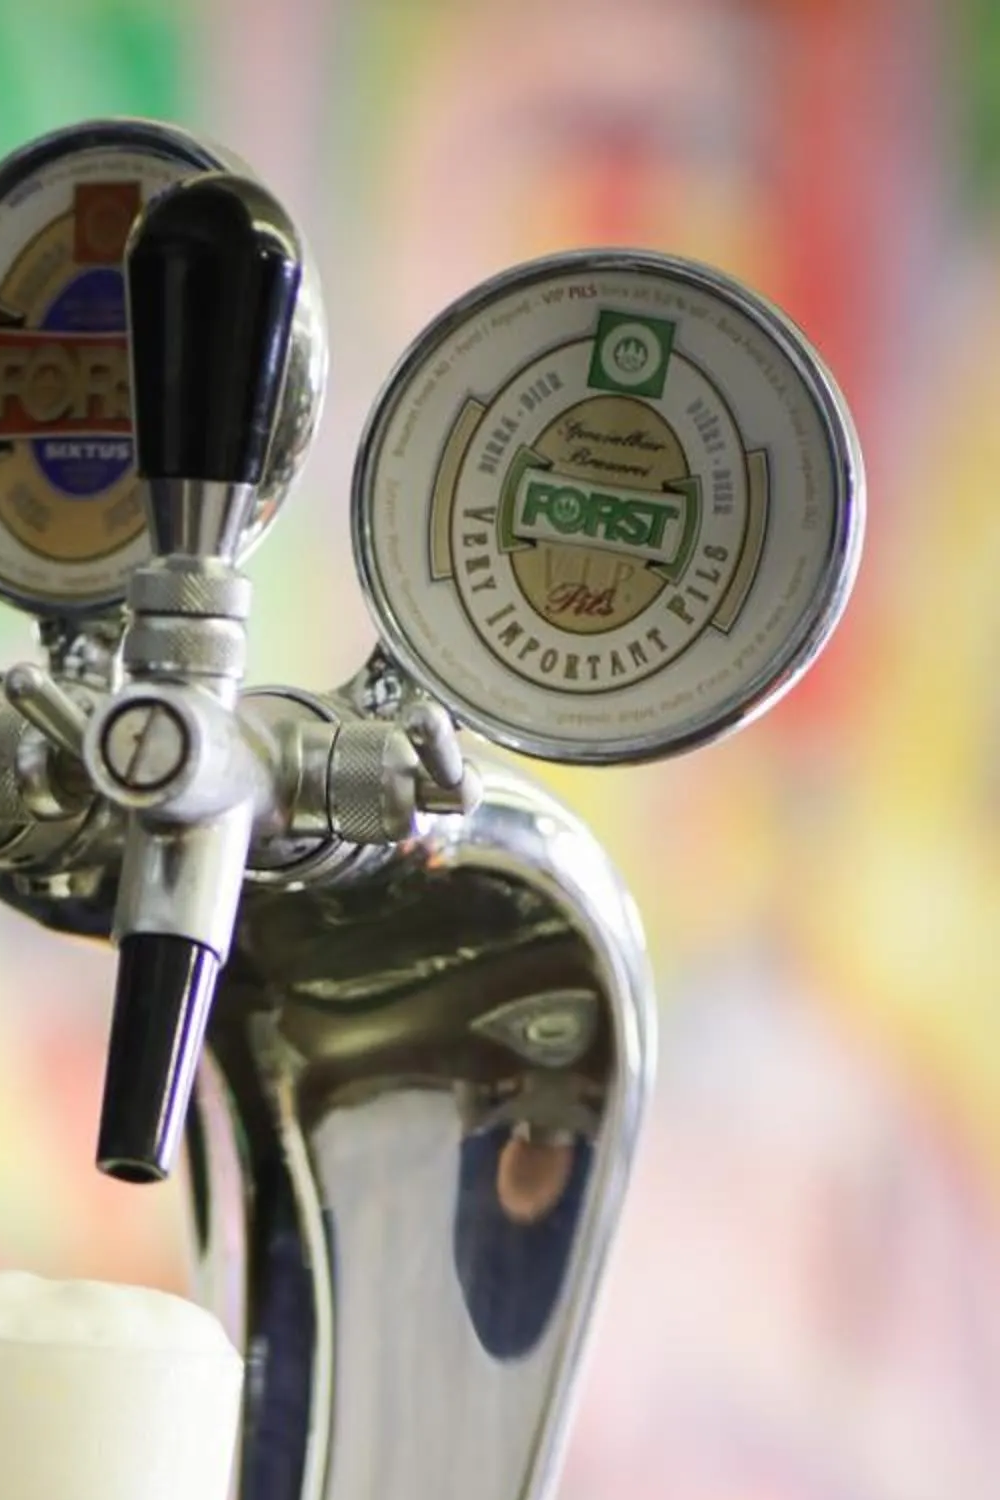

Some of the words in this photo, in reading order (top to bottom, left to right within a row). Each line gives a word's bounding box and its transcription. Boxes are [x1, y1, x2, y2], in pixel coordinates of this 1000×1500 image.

[568, 284, 598, 301] PILS
[45, 442, 131, 460] SIXTUS
[521, 480, 680, 550] FORST
[462, 505, 498, 593] VERY
[486, 603, 670, 681] IMPORTANT
[666, 543, 730, 626] PILS
[544, 580, 616, 617] Pils
